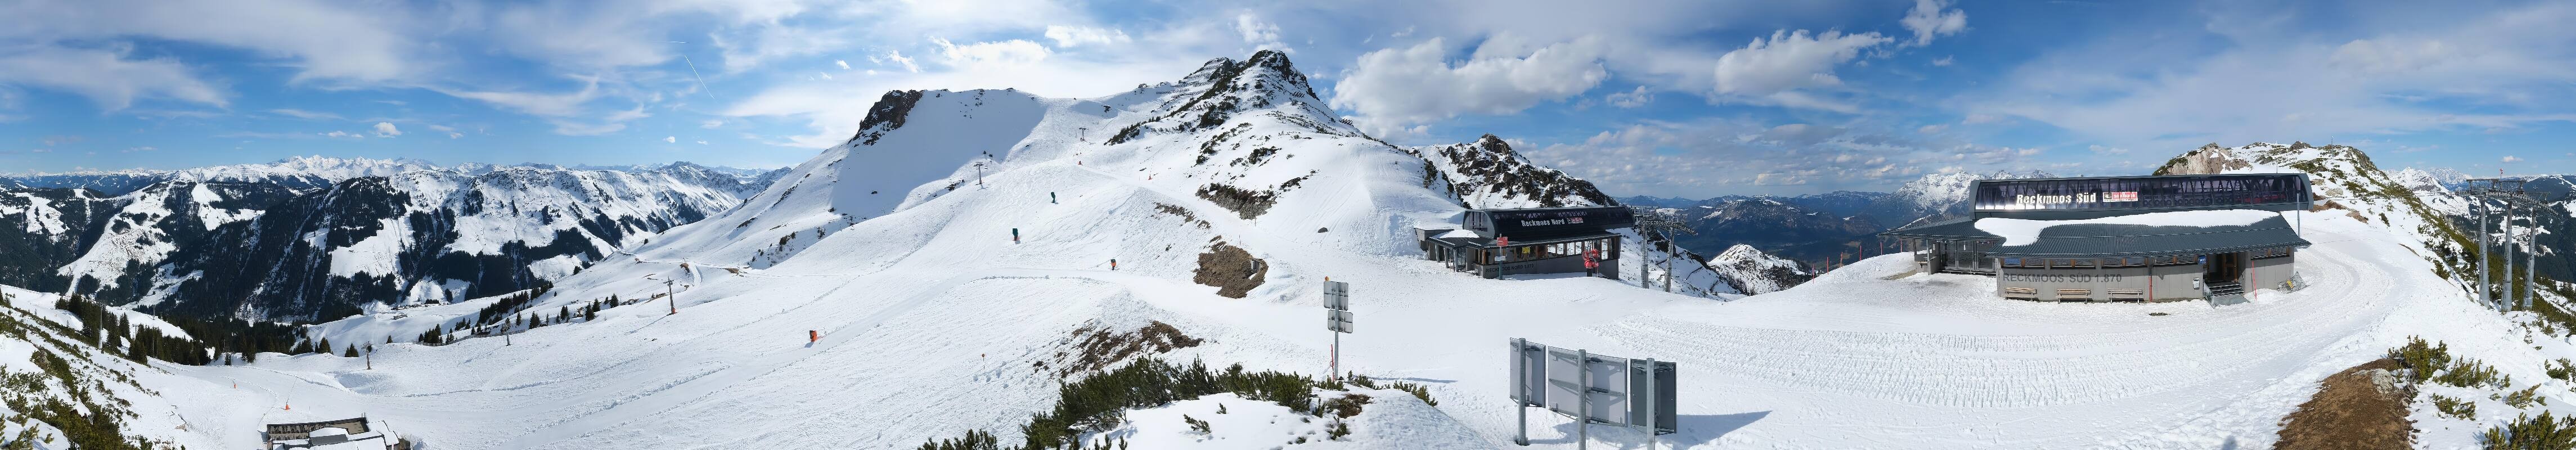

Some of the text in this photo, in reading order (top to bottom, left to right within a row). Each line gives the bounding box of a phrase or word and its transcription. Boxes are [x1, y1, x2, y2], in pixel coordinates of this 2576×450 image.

[2016, 192, 2096, 204] Reckmoos Süd
[2003, 272, 2122, 283] RECKMOOS SÜD 1.870
